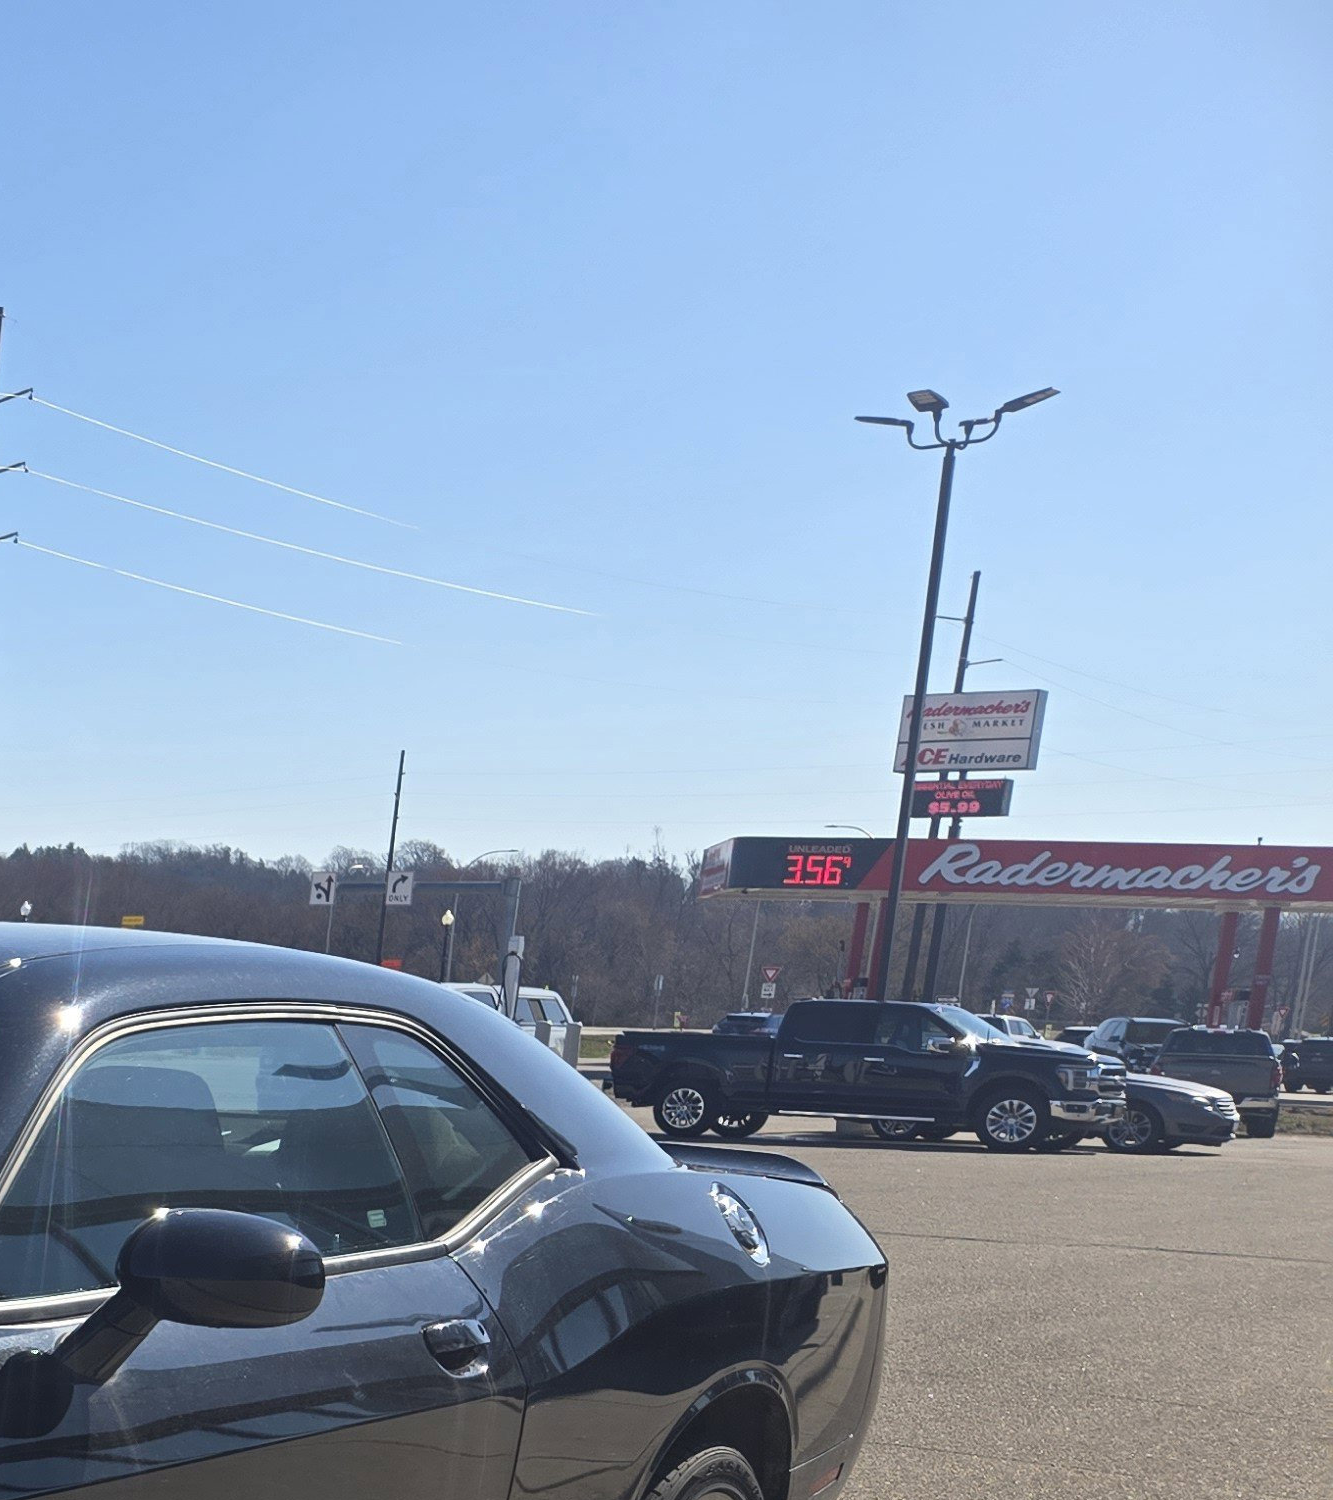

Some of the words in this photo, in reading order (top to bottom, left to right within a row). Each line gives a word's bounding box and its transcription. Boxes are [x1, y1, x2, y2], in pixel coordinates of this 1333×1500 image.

[972, 719, 1025, 729] MARKET
[901, 747, 949, 766] CE
[948, 752, 1022, 765] Hardware
[958, 780, 1004, 790] EVERYDAY
[928, 800, 981, 815] $5.99
[789, 845, 851, 854] UNLEADED
[919, 843, 1321, 894] Radermacher's
